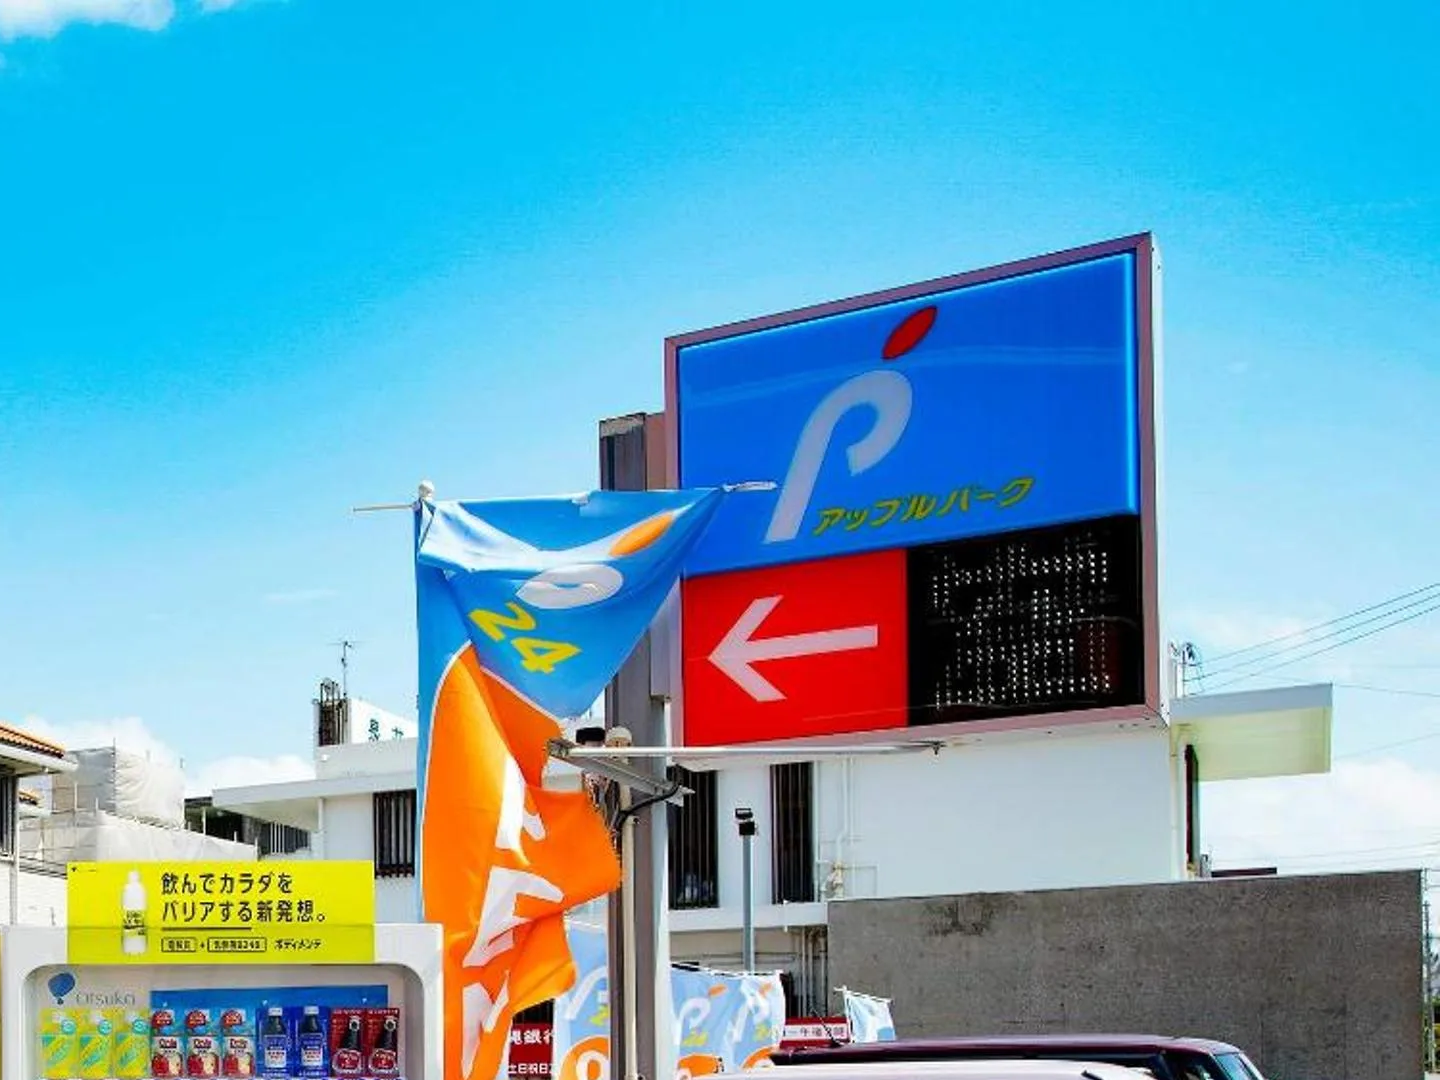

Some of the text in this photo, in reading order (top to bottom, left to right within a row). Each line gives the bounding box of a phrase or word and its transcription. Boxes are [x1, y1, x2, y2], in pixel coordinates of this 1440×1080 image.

[813, 477, 1035, 535] アップルパーク
[161, 872, 293, 894] 飲んでカラダを
[161, 900, 326, 923] バリアする新発想。
